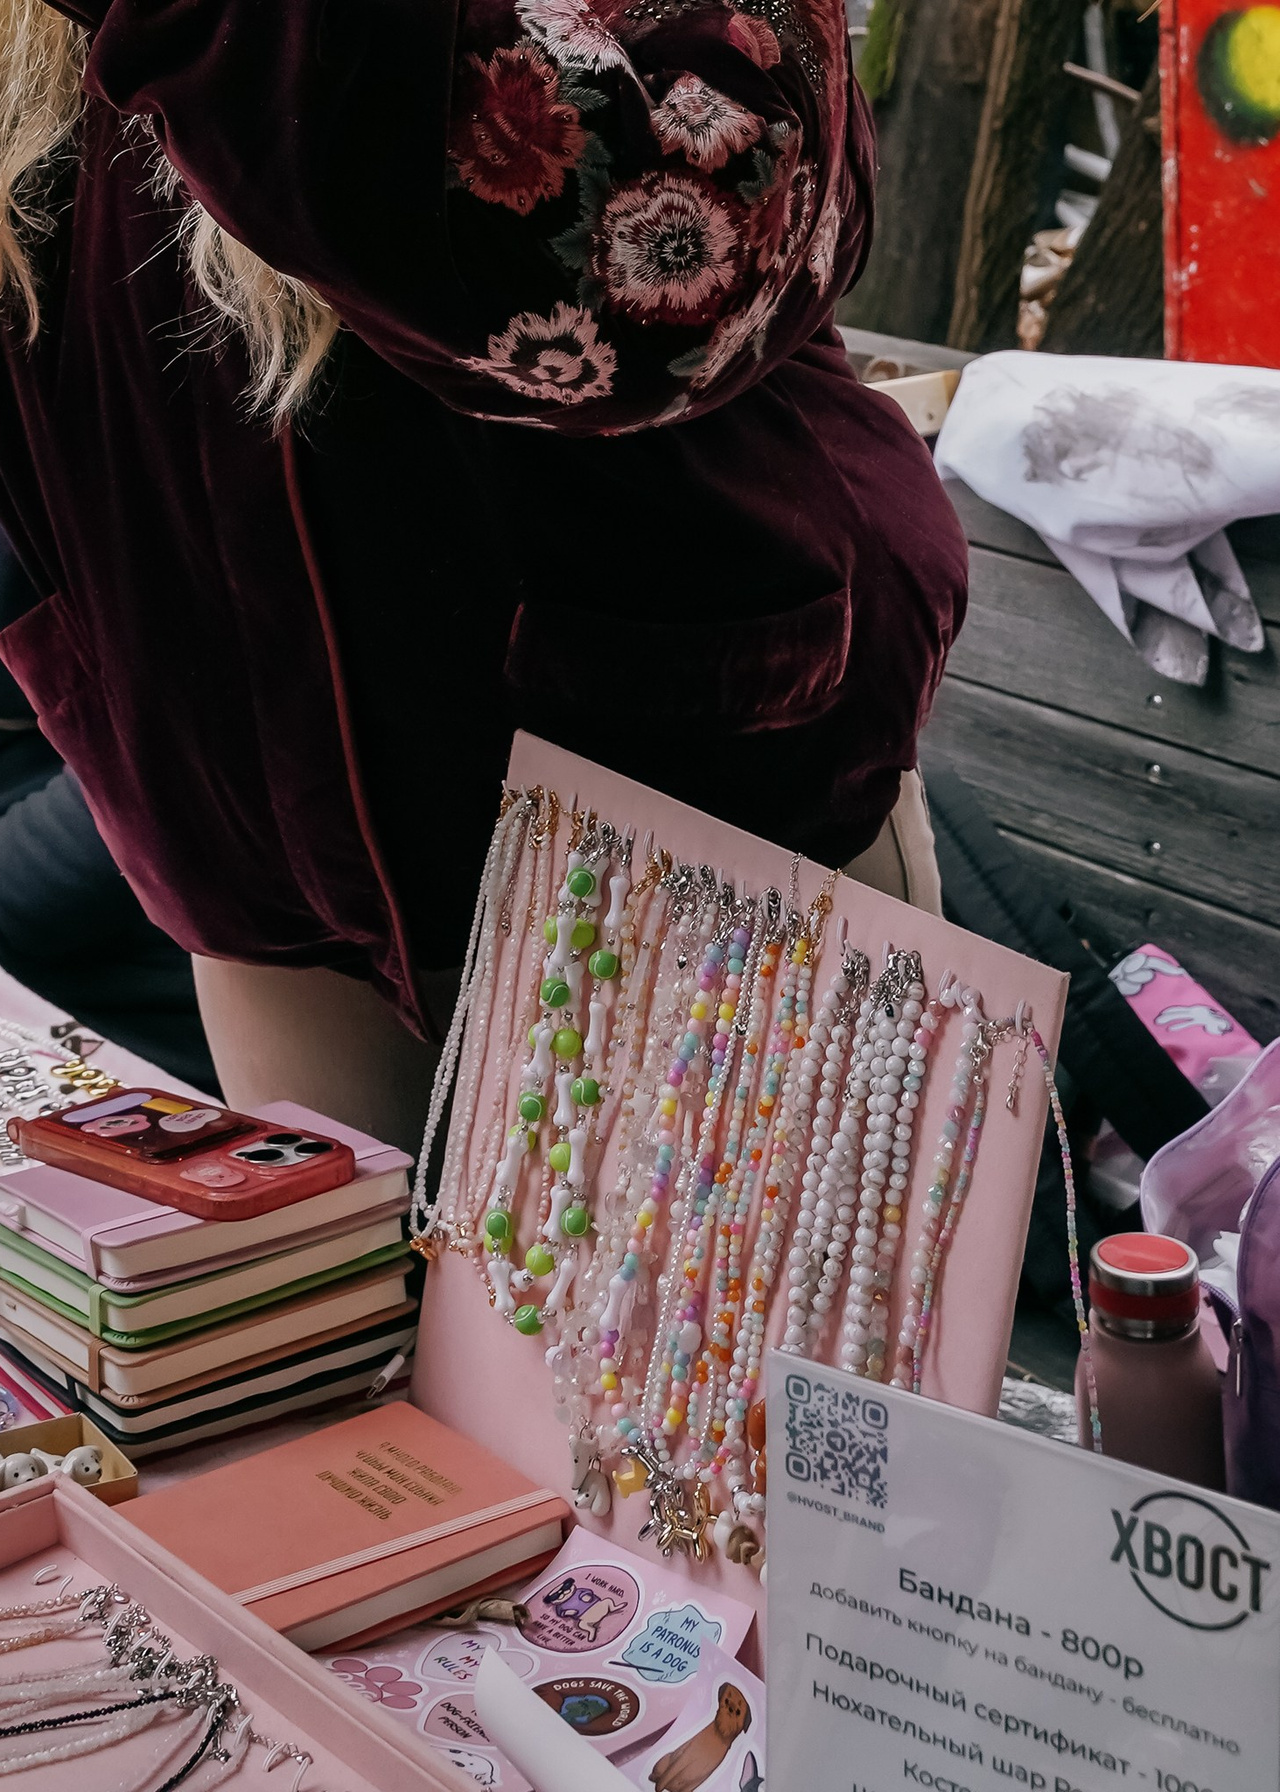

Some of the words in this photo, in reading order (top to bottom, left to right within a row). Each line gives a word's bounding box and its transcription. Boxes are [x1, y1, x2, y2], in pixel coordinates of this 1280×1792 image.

[384, 1445, 420, 1468] МНОГО
[372, 1484, 407, 1505] СВОЮ
[356, 1495, 393, 1521] ЖИЗНЬ
[1110, 1508, 1271, 1612] ХВОСТ
[591, 1576, 609, 1589] WORK
[540, 1613, 550, 1621] SO
[550, 1618, 561, 1627] MY
[558, 1623, 573, 1634] DOG
[573, 1631, 586, 1641] CAN
[680, 1616, 700, 1633] MY
[898, 1566, 1032, 1637] Бандана
[1061, 1628, 1145, 1680] 800р
[461, 1639, 487, 1652] MY
[552, 1632, 575, 1646] BETTER
[650, 1625, 701, 1658] PATRONUS
[434, 1656, 473, 1680] RULES
[458, 1655, 480, 1668] MY
[639, 1641, 654, 1654] IS
[651, 1647, 664, 1659] A
[662, 1653, 688, 1672] DOG
[809, 1581, 903, 1627] добавить
[907, 1618, 980, 1658] кнопку
[984, 1647, 1008, 1667] на
[1014, 1654, 1104, 1705] бандану
[1122, 1695, 1242, 1756] бесплатно
[553, 1680, 585, 1691] DOGS
[589, 1680, 615, 1692] SAVE
[614, 1689, 629, 1702] THE
[806, 1632, 966, 1713] Подарочный
[973, 1701, 1131, 1777] сертификат
[438, 1716, 472, 1739] PERSON
[812, 1679, 983, 1766] Нюхательный
[992, 1755, 1046, 1790] шар
